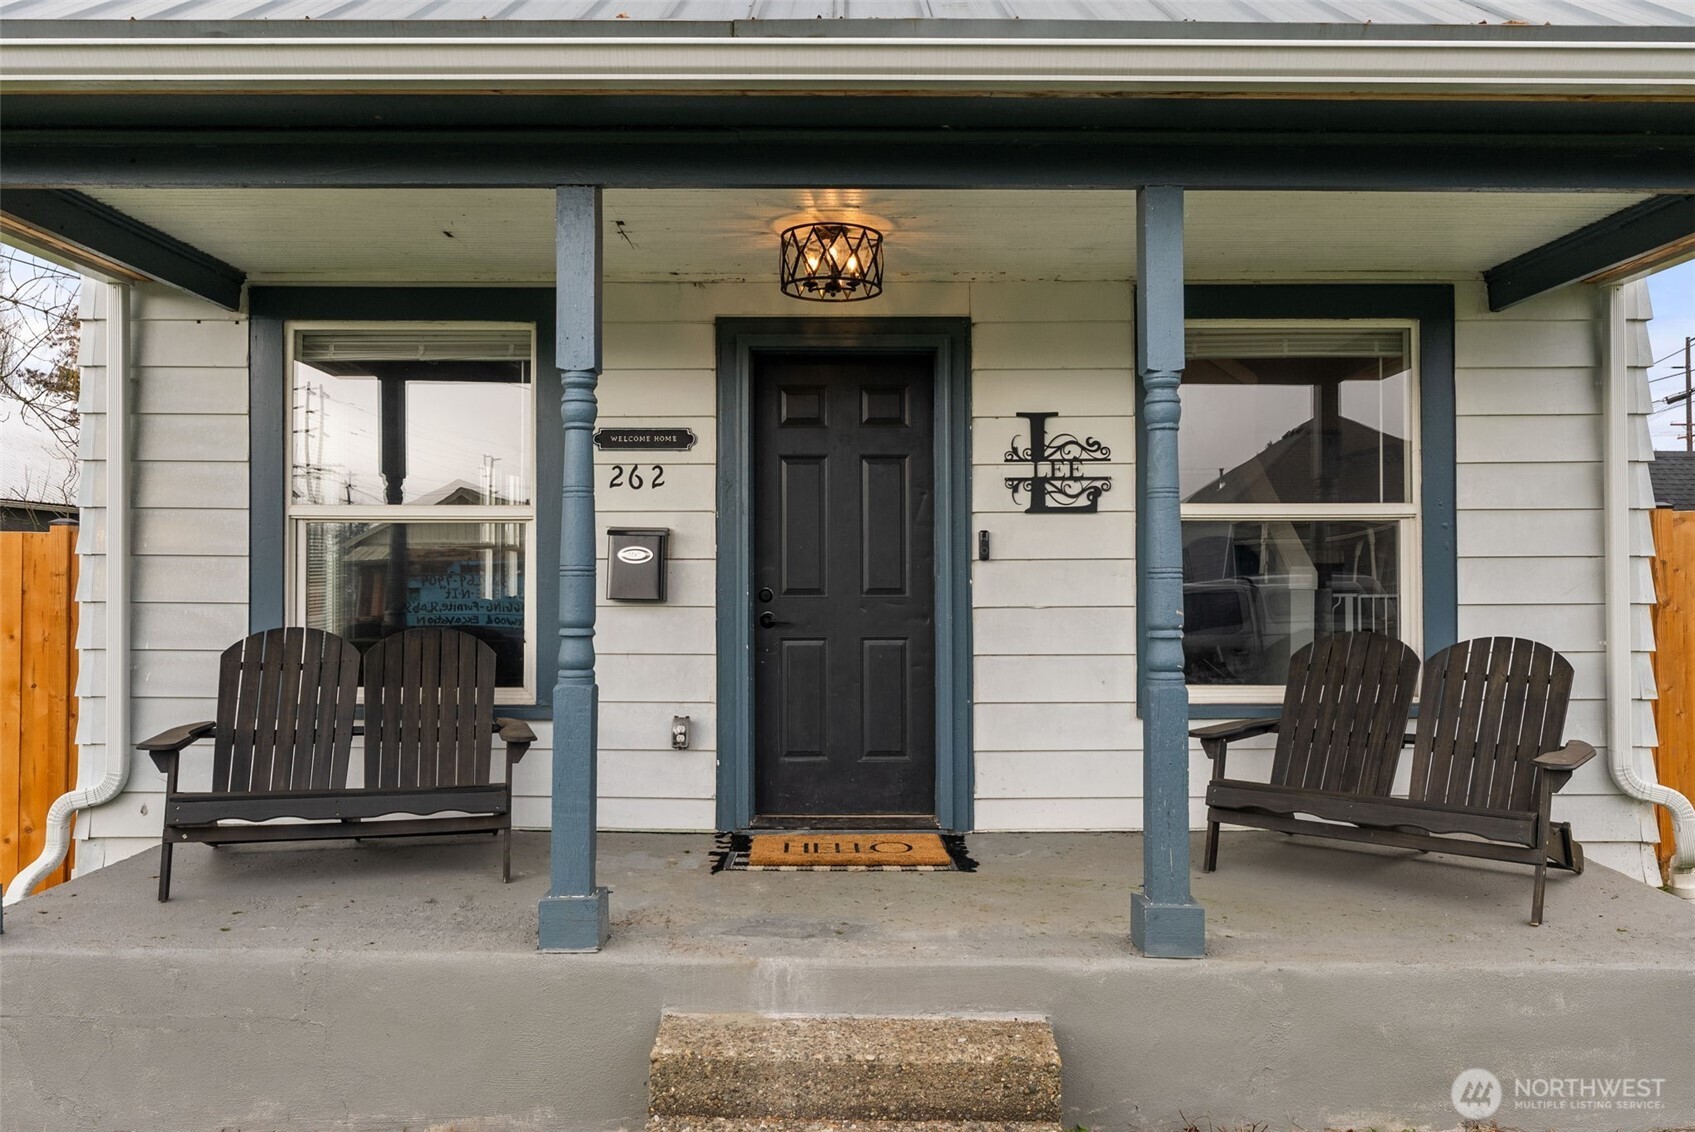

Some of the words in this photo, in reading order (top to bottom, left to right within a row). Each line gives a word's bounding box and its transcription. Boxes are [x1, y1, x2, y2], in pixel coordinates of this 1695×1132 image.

[609, 464, 665, 490] 262
[1033, 461, 1084, 478] LEE
[783, 841, 914, 854] HELLO
